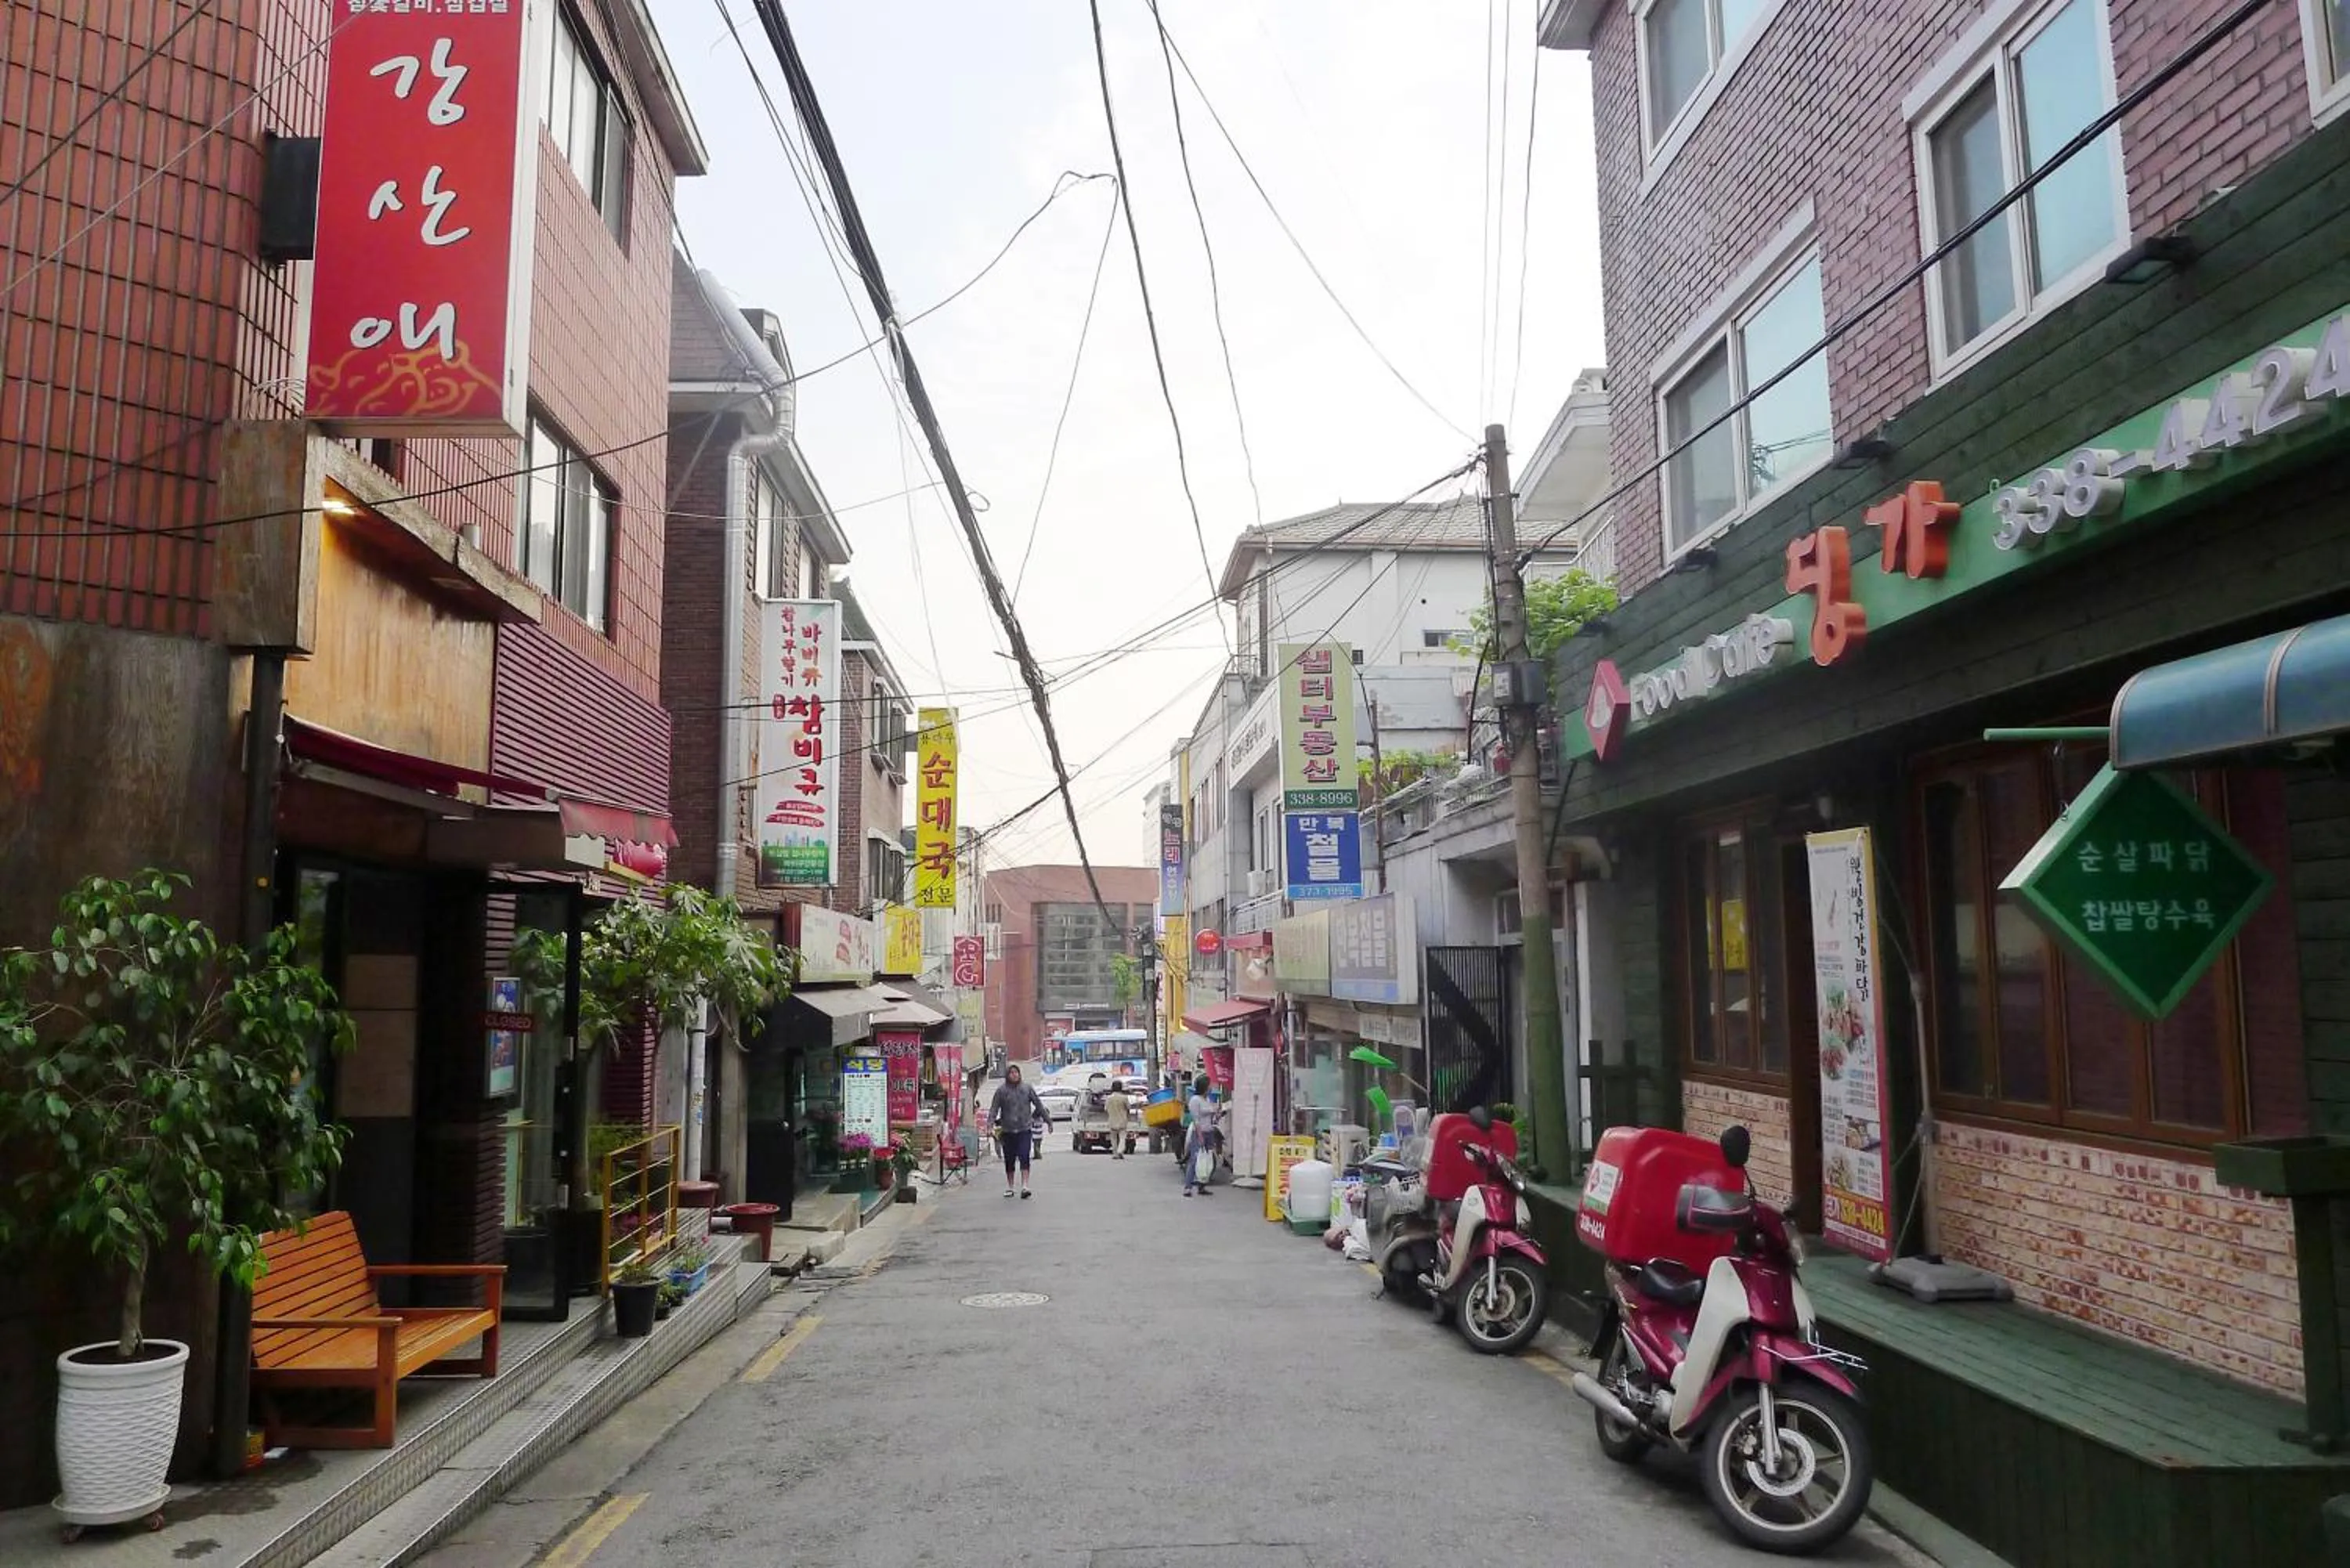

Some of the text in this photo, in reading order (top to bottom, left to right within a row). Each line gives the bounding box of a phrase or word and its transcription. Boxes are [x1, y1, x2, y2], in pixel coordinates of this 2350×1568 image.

[1992, 315, 2350, 551] 338-4424
[1289, 790, 1354, 805] 338-8996
[921, 752, 955, 880] 순대국
[2077, 840, 2211, 873] 순살파닭
[920, 887, 953, 905] 전문
[2081, 901, 2216, 932] 찹쌀탕수육
